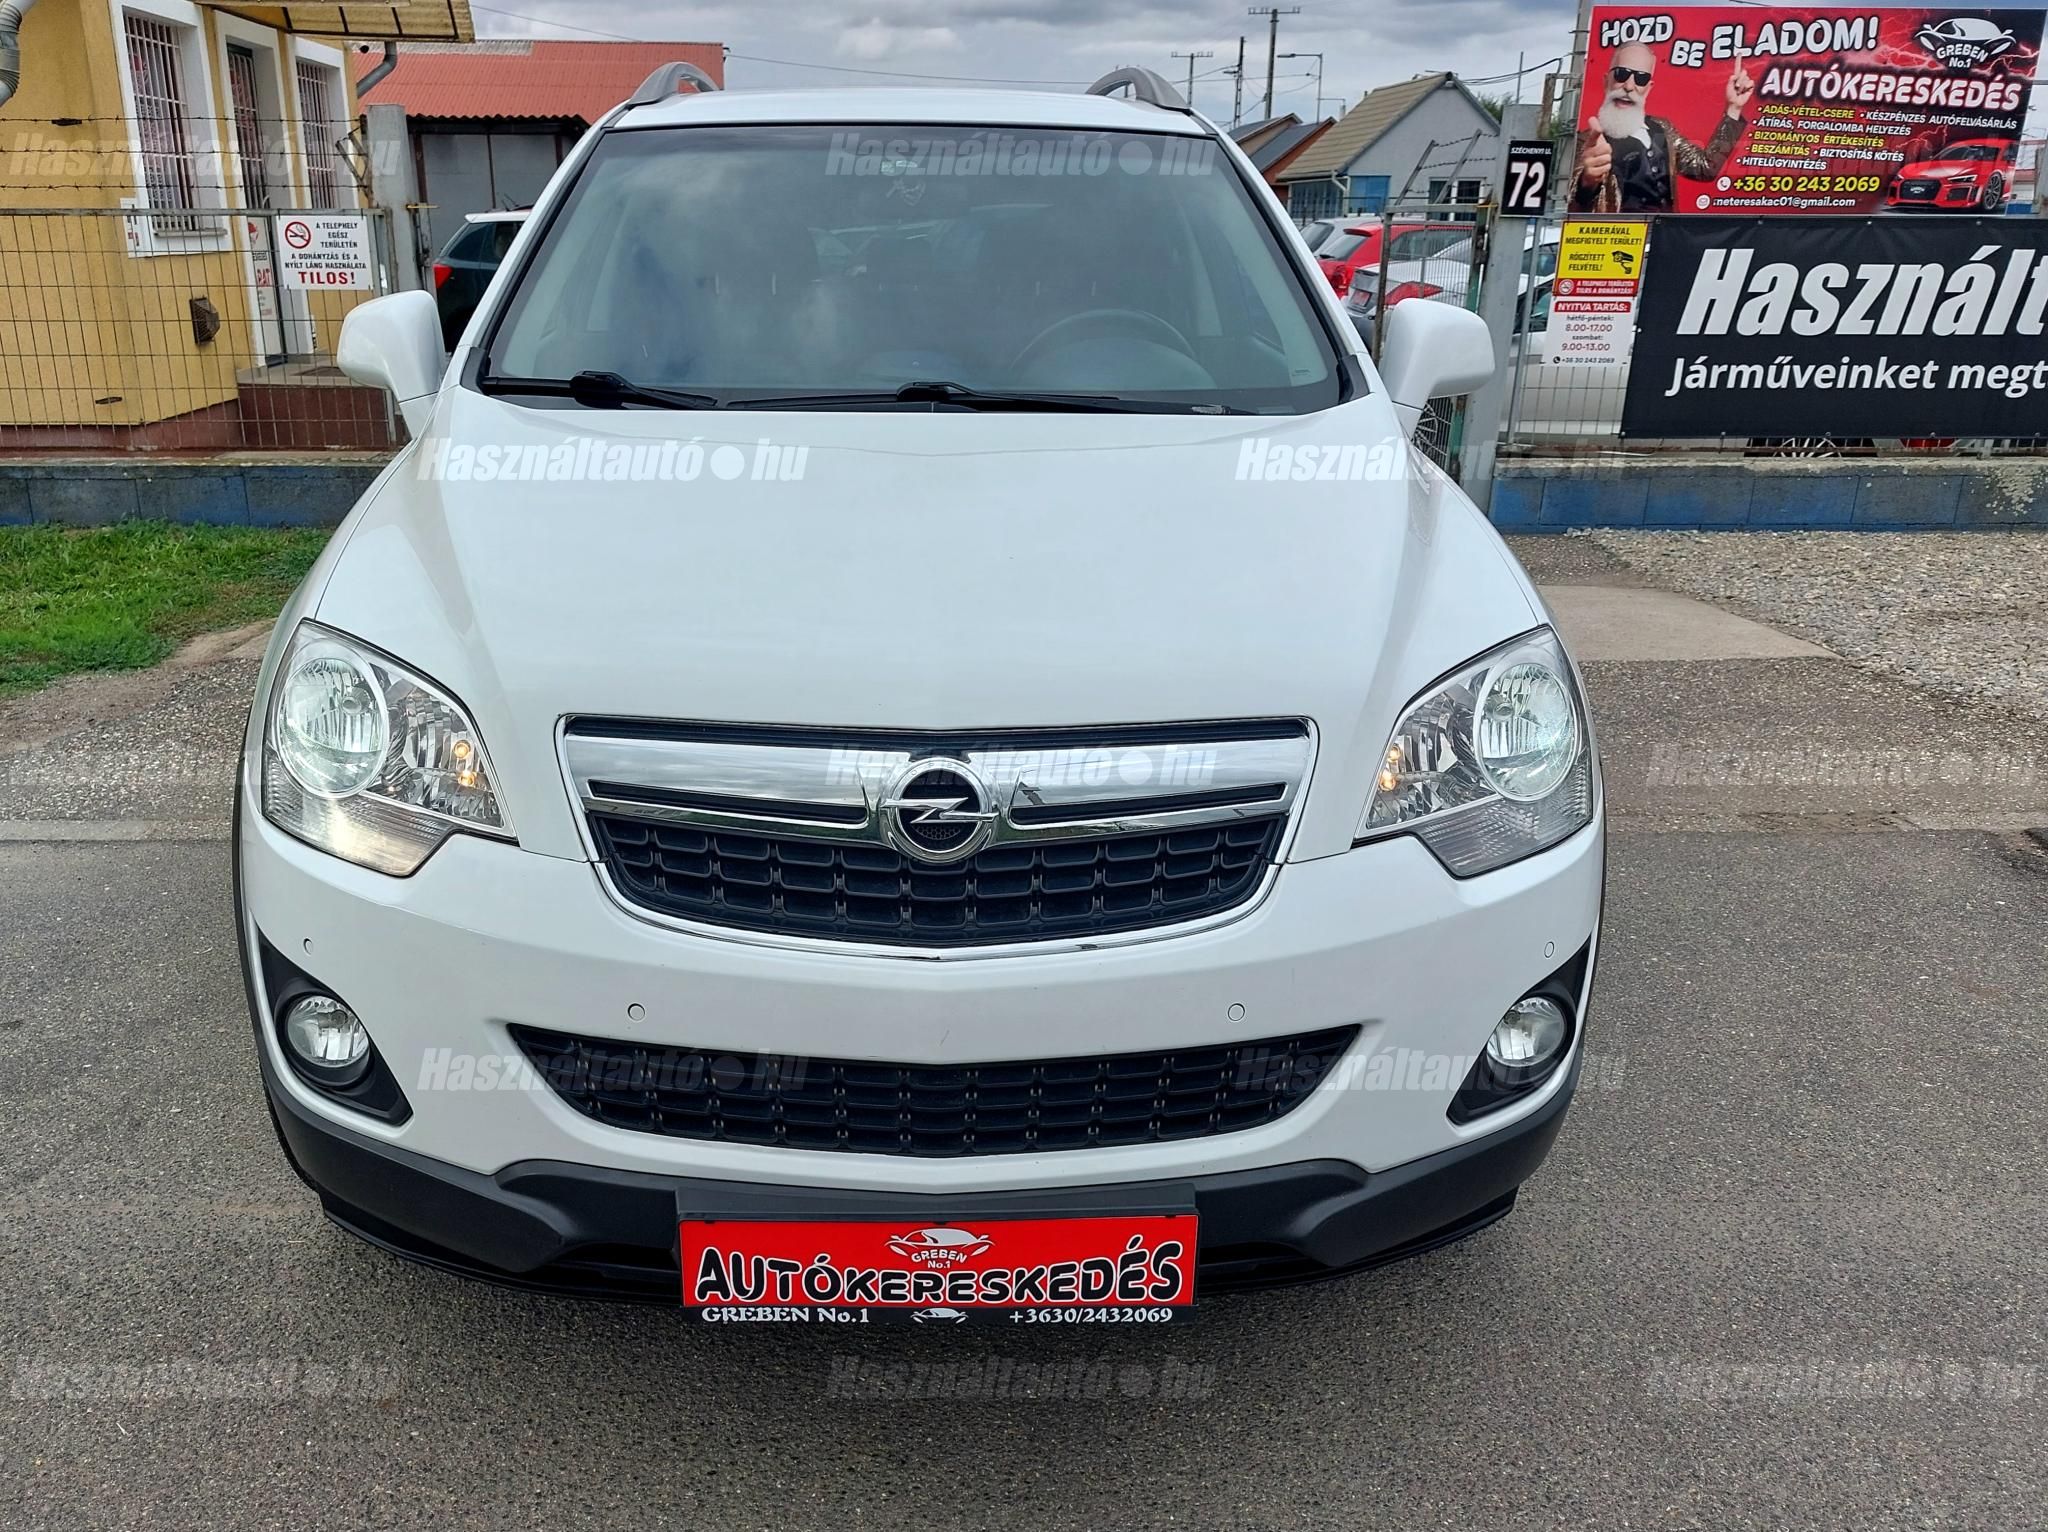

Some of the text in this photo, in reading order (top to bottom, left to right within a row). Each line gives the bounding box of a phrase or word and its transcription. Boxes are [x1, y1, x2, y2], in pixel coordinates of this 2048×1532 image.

[1601, 15, 1674, 48] HOZD
[1670, 16, 1879, 68] BE ELADOM!
[1936, 44, 1988, 62] GREBEN
[1949, 57, 1972, 68] No.1
[1761, 64, 2022, 111] AUTÓKERESKEDÉS
[1762, 103, 1855, 118] ADÁS-VÉTEL-CSERE
[1757, 116, 1912, 136] ÁTÍRÁS, FORGALOMBA HELYEZÉS
[1866, 110, 2018, 129] KÉSZPÉNZES AUTÓFELVÁSÁRLÁS
[1754, 129, 1884, 147] BIZOMÁNYOS ÉRTÉKESÍTÉS
[1751, 144, 1810, 156] BESZÁMÍTÁS
[1819, 147, 1873, 160] BIZTOSÍTÁS
[1742, 155, 1827, 170] HITELÜGYINTÉZÉS
[1508, 162, 1545, 208] 72
[1733, 176, 1881, 192] +36 30 243 2069
[328, 229, 348, 239] EGÉSZ
[1579, 226, 1631, 235] KAMERÁVAL
[320, 240, 358, 248] TERÜLETÉN
[299, 252, 339, 260] DOHÁNYZÁS
[342, 252, 350, 260] ÉS
[306, 260, 323, 269] LÁNG
[325, 260, 366, 269] HASZNÁLATA
[298, 271, 356, 285] TILOS!
[1676, 245, 2048, 336] Használt
[1558, 302, 1628, 311] NYITVA TARTÁS:
[1565, 324, 1613, 332] 8.00-17.00
[1561, 343, 1611, 351] 9.00-13.00
[1665, 356, 2048, 398] Járműveinket megt
[911, 1249, 967, 1263] GREBEN
[695, 1235, 1185, 1304] AUTÓKERESKEDÉS
[927, 1260, 951, 1269] No.1
[701, 1307, 1173, 1324] GREBEN No.1 +3630/2432069
